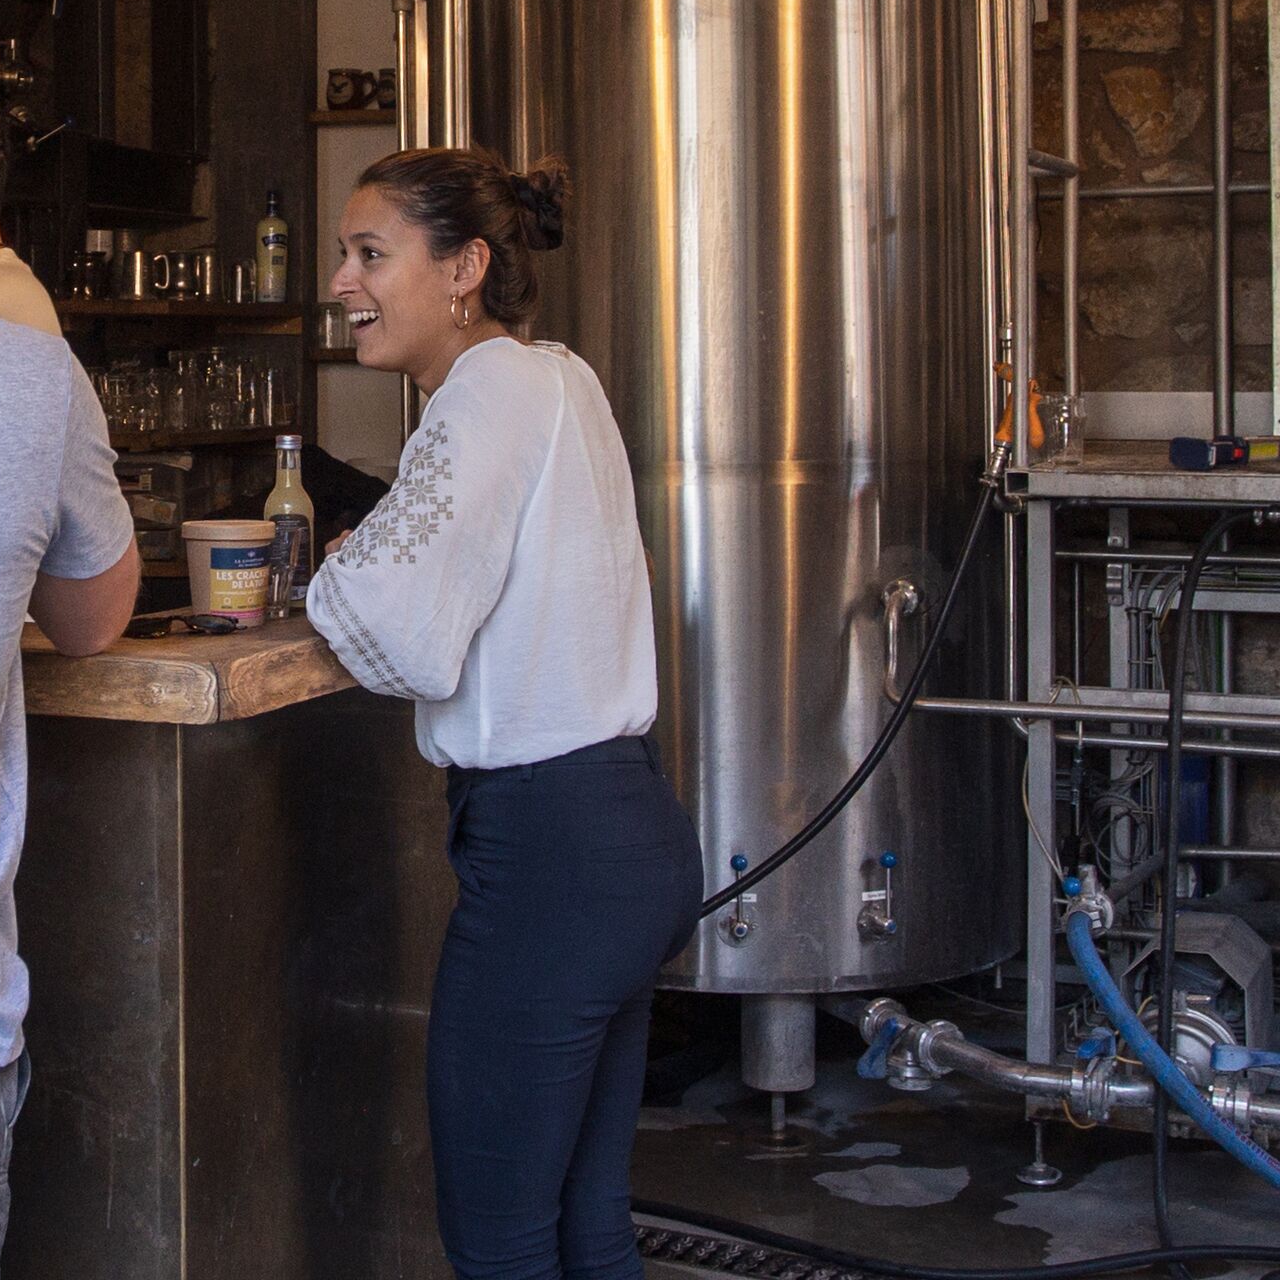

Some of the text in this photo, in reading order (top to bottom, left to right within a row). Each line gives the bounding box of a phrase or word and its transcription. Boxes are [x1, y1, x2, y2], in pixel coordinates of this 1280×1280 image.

[216, 571, 233, 581] LES
[232, 580, 244, 589] DE
[244, 579, 255, 588] LA
